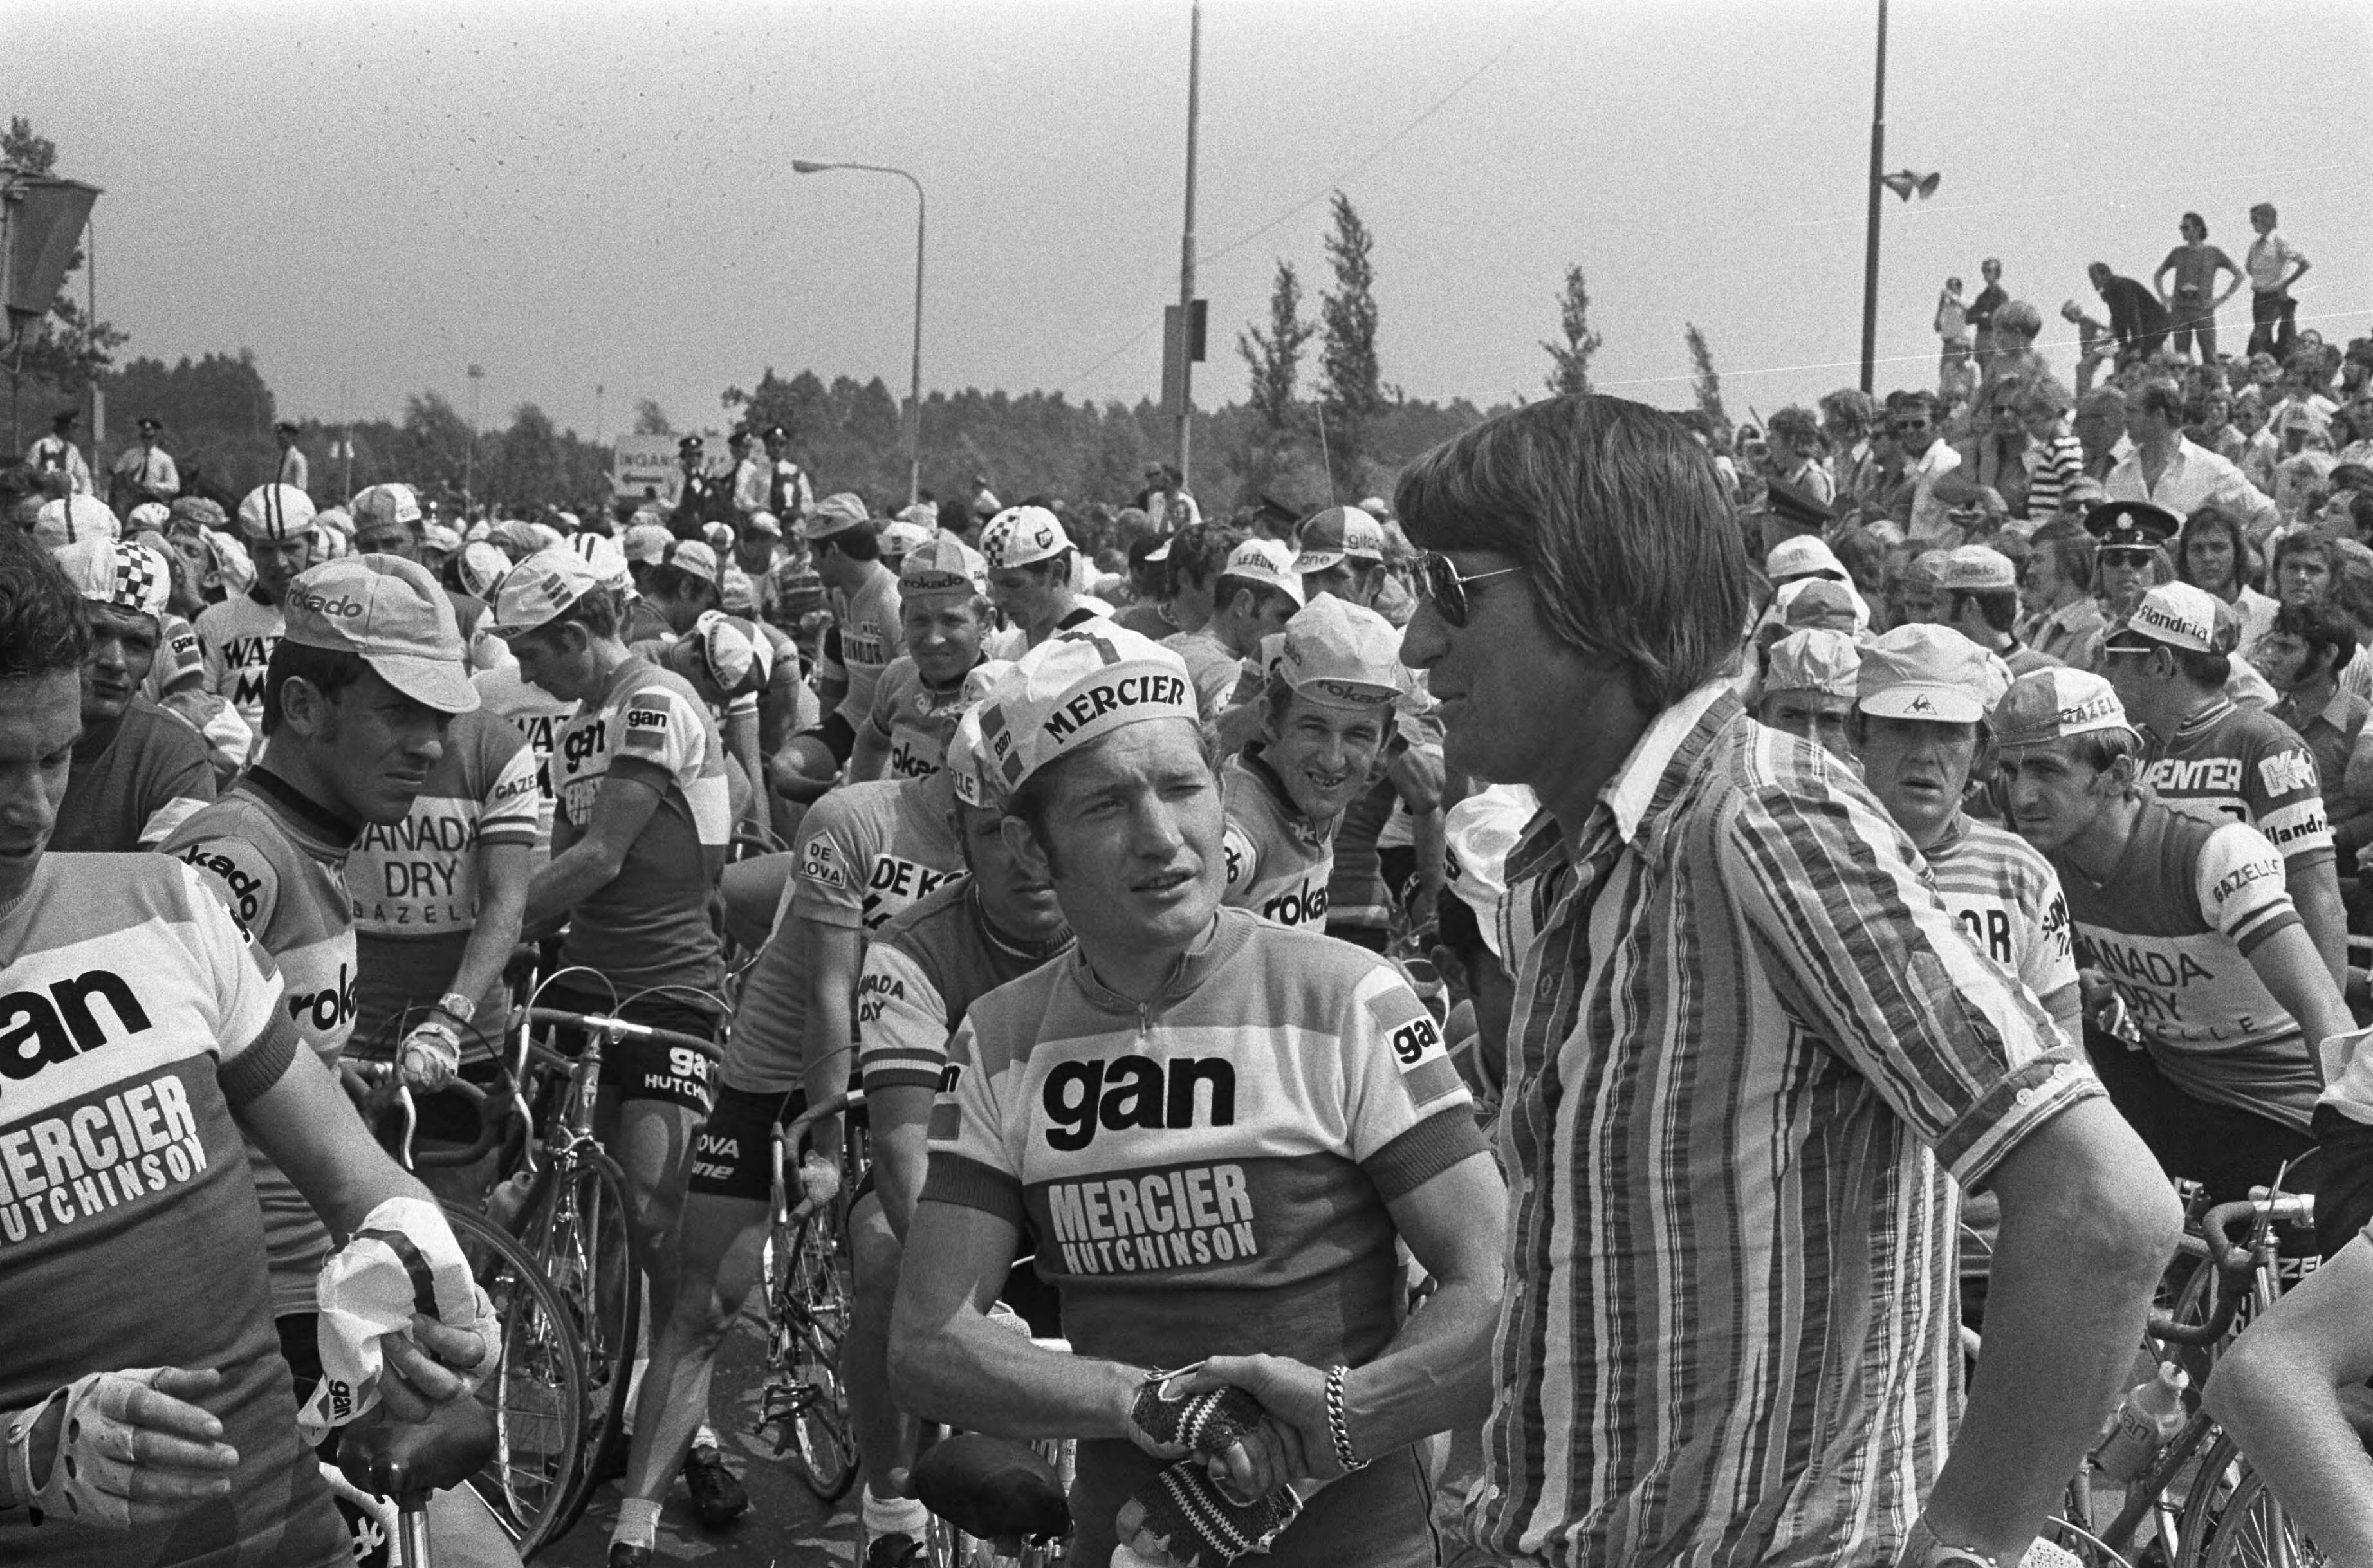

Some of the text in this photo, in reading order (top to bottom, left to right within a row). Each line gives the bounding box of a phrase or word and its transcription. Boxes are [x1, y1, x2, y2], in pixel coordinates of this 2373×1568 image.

[904, 574, 964, 589] rokado
[2138, 604, 2208, 641] flandria
[628, 710, 667, 727] gan
[1044, 675, 1185, 744] MERCIER
[993, 730, 1012, 761] gan
[353, 815, 481, 852] ANADA
[810, 843, 831, 861] DE
[179, 845, 261, 921] kado
[385, 858, 457, 898] DRY
[804, 862, 840, 883] OVA
[870, 858, 914, 896] DE
[1043, 1055, 1235, 1151] gan
[1049, 1164, 1254, 1242] MERCIER
[1062, 1221, 1258, 1275] HUTCHINSON
[329, 1379, 352, 1420] gan
